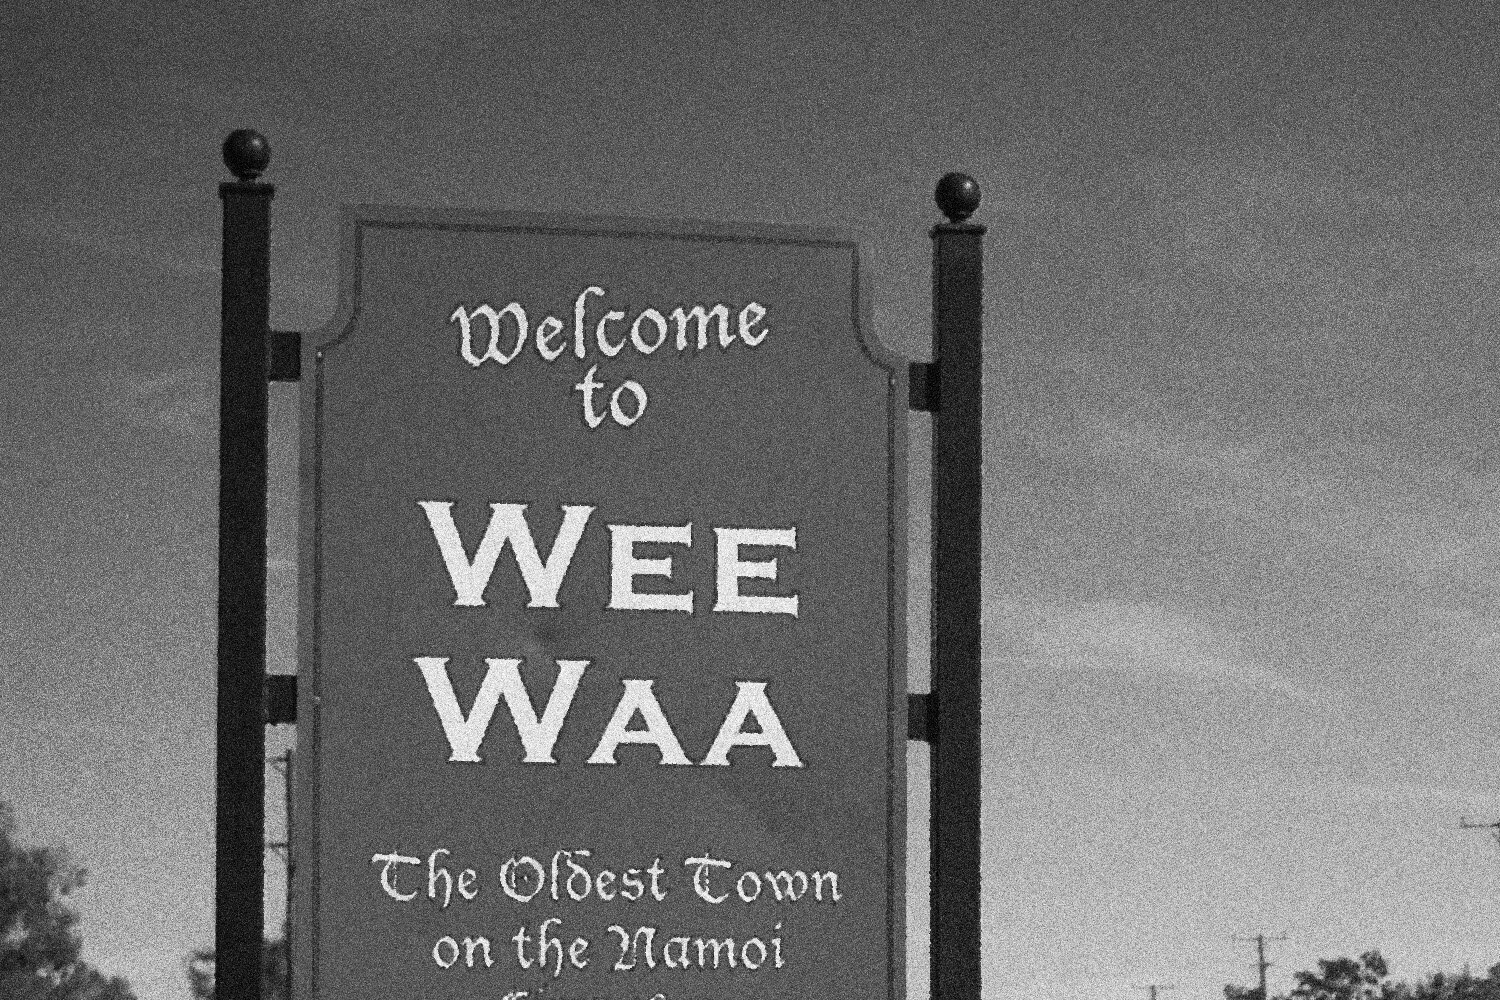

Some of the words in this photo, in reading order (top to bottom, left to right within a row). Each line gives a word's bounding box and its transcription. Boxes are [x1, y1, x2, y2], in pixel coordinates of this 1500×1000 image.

[450, 286, 769, 367] Welcome
[575, 365, 648, 428] to
[417, 501, 800, 618] WEE
[412, 656, 804, 768] WAA
[371, 848, 478, 908] The
[499, 849, 667, 902] Oldest
[684, 852, 843, 904] Town
[431, 935, 494, 969] on
[511, 917, 589, 977] the
[607, 921, 786, 972] Namoi
